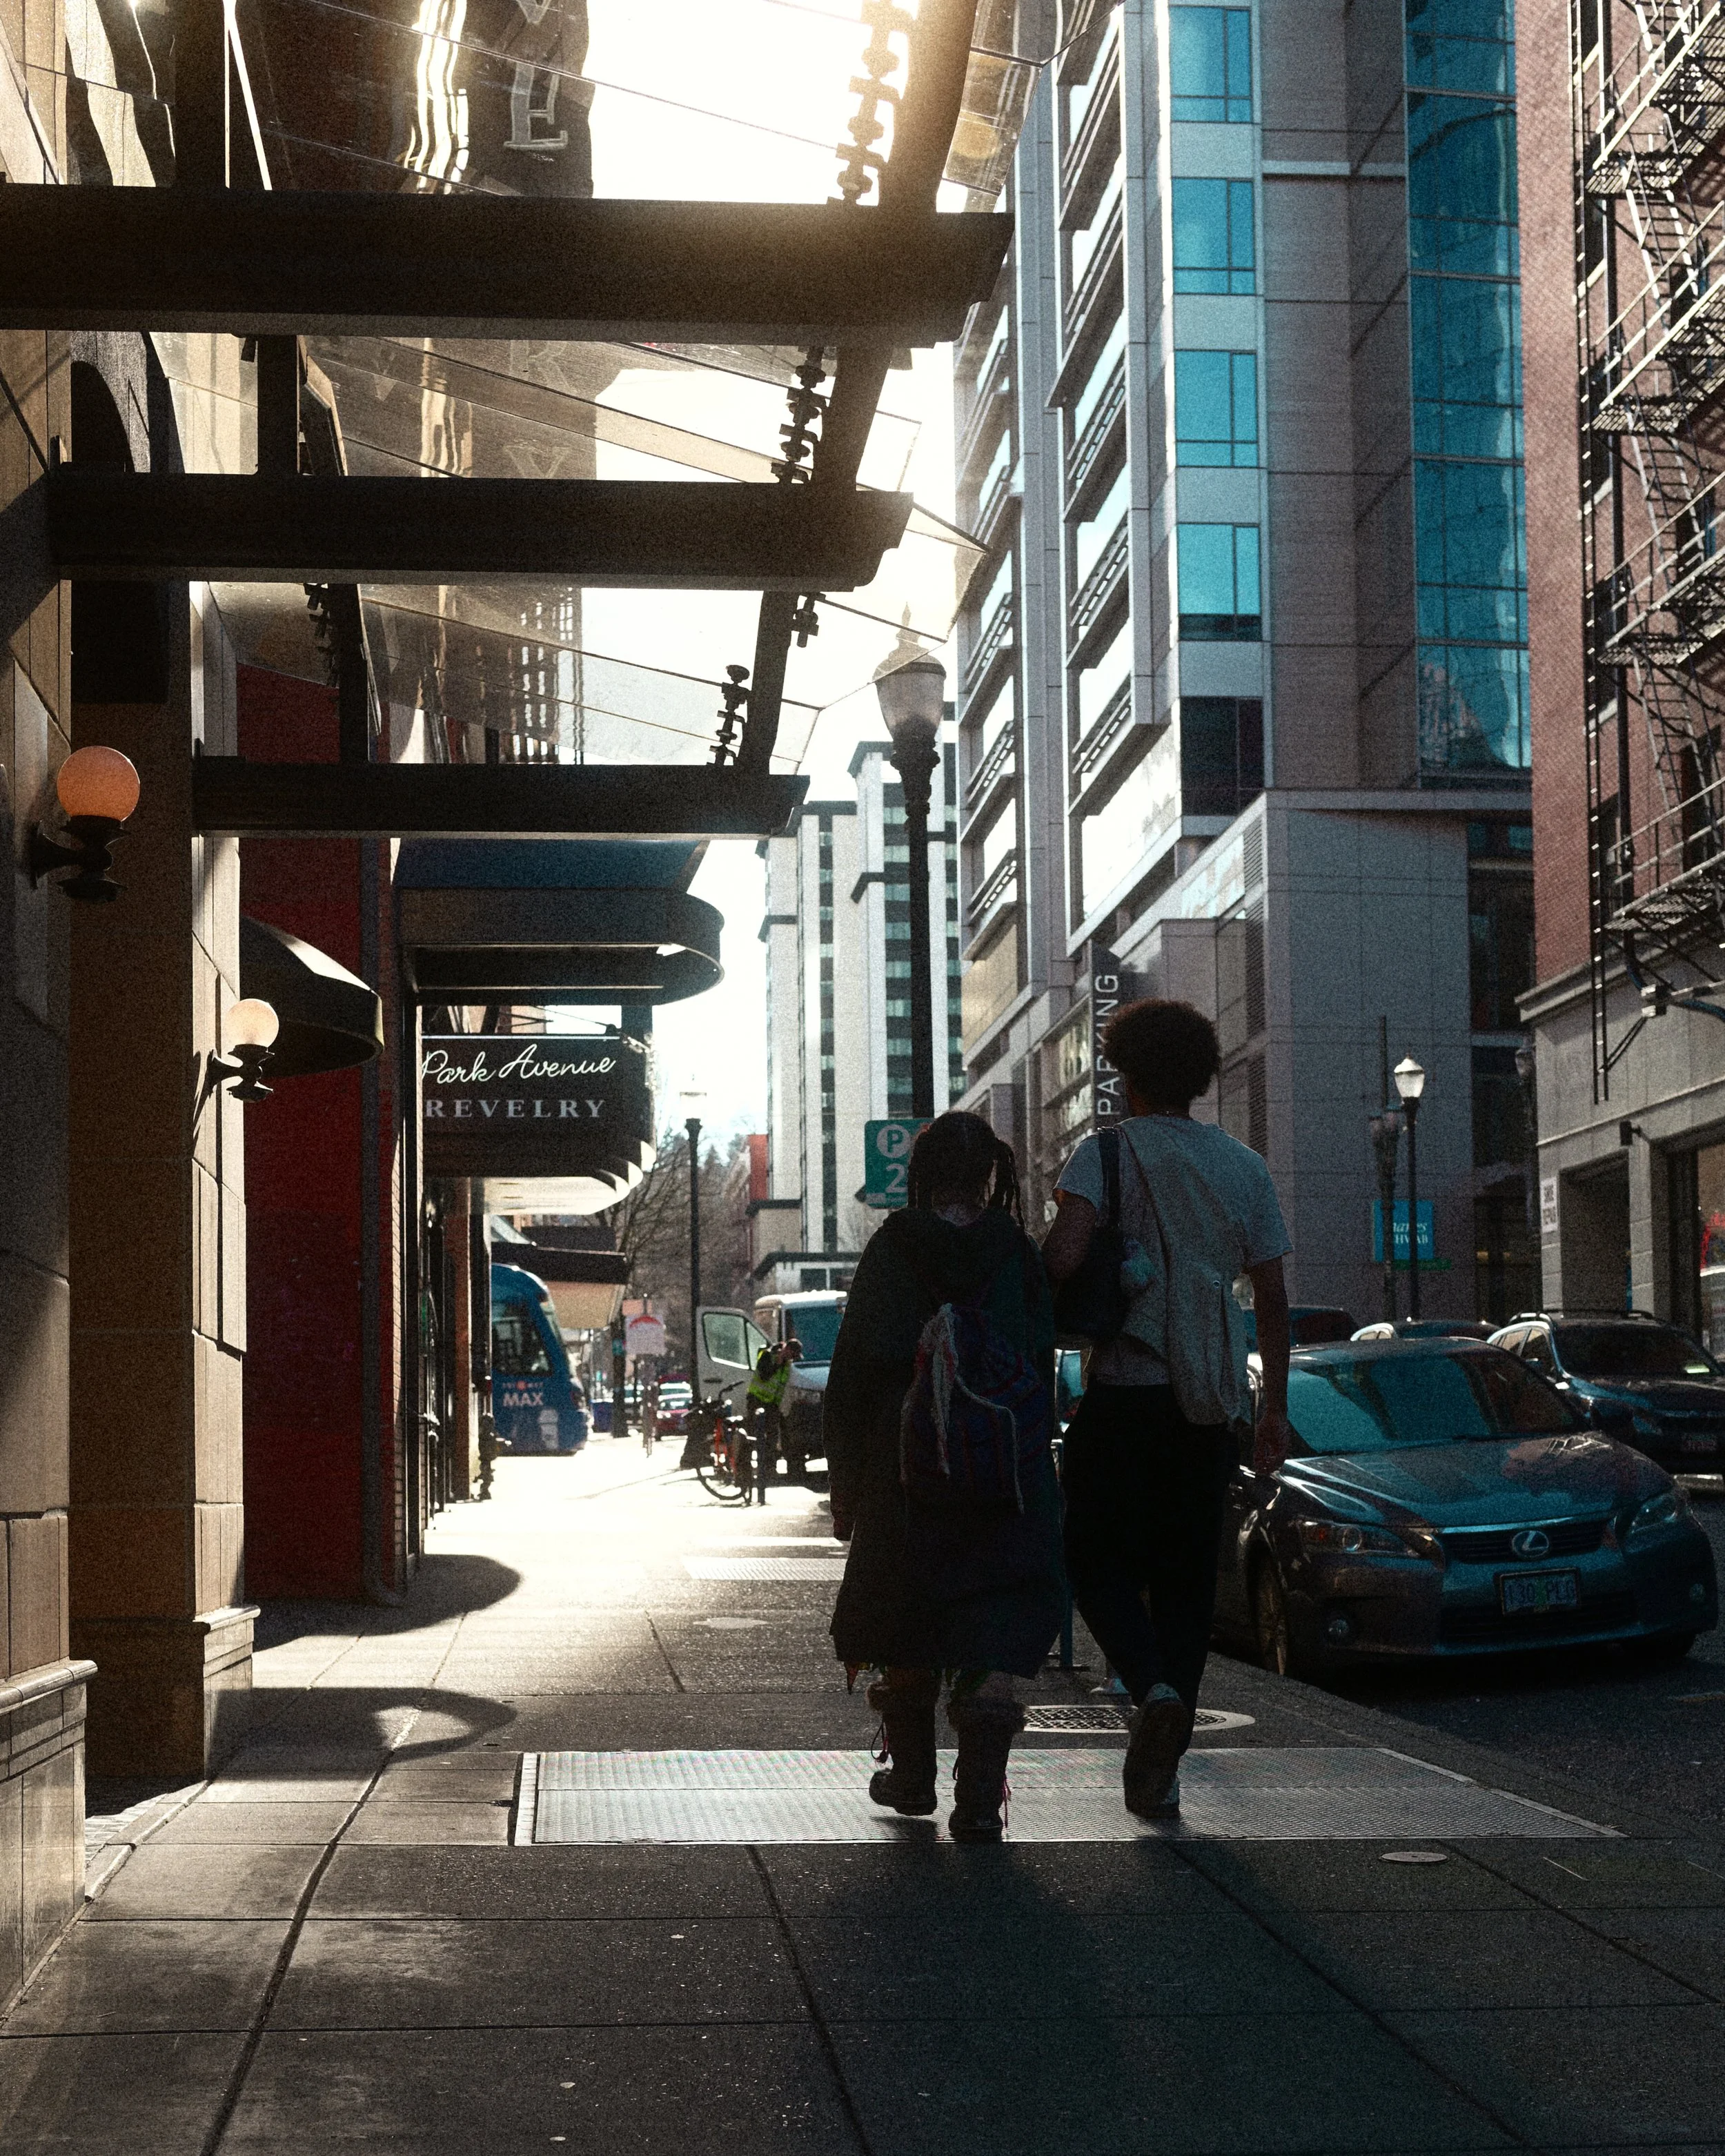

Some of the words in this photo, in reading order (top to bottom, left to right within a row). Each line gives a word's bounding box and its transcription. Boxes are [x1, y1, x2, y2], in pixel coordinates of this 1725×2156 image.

[421, 1049, 496, 1084] Park
[498, 1043, 616, 1079] Avenue
[425, 1098, 605, 1118] REVELRY
[887, 1129, 904, 1152] P
[502, 1392, 544, 1407] MAX
